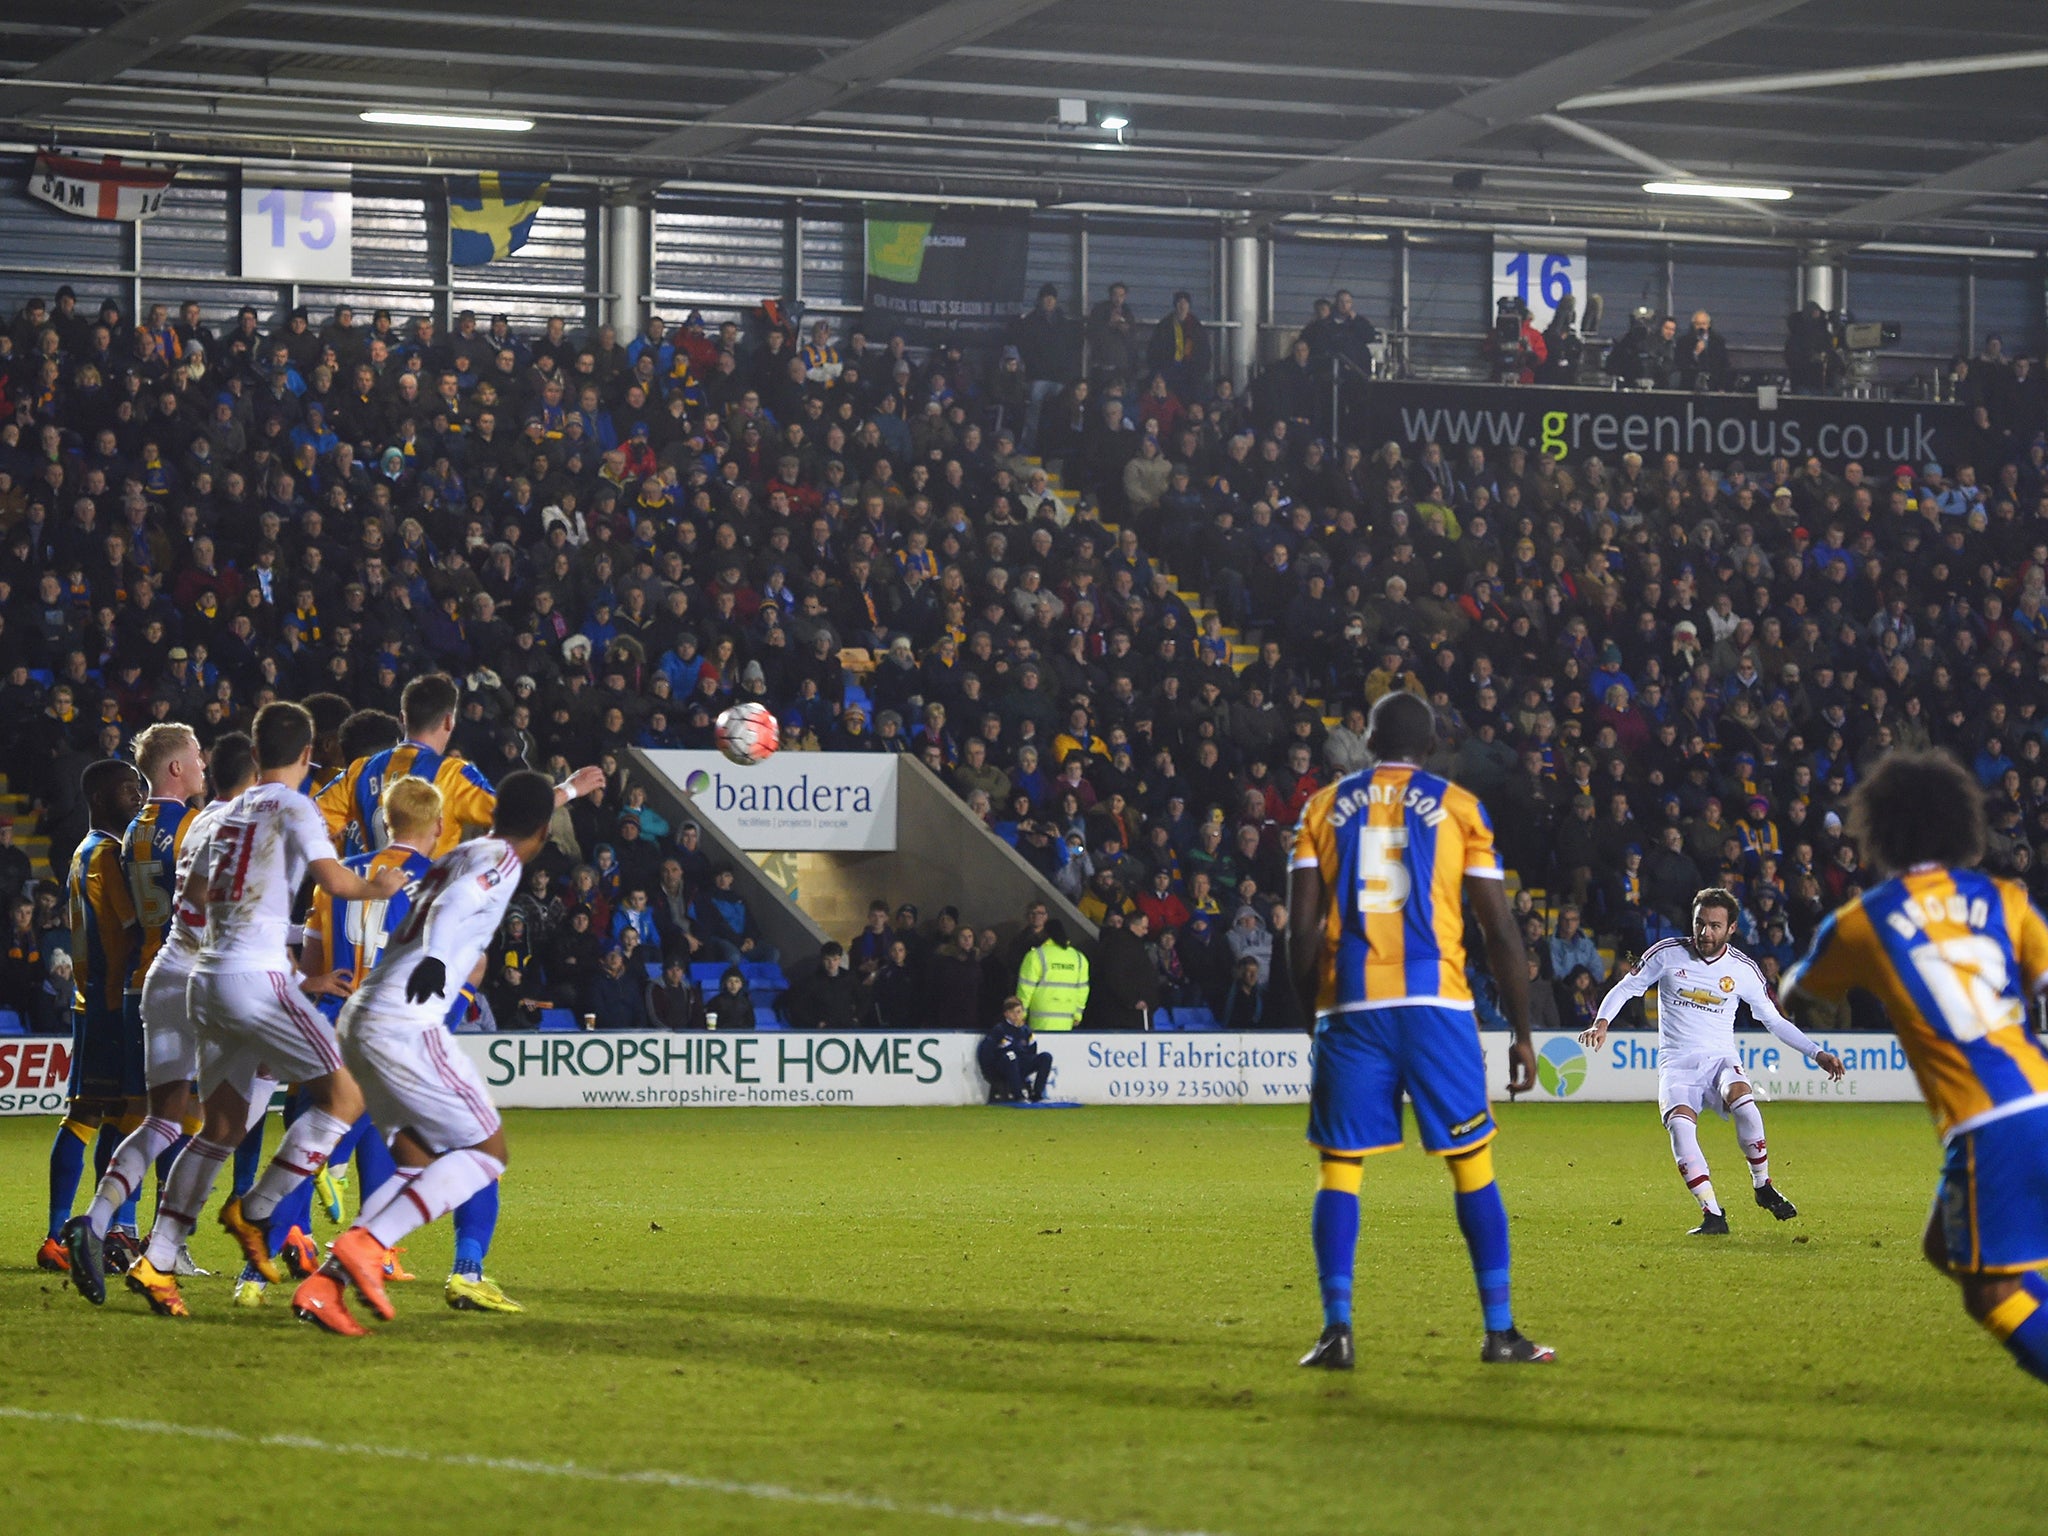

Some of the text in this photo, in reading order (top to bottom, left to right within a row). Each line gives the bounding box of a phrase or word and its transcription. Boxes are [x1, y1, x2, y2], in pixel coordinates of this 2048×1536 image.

[42, 173, 84, 208] SAM
[258, 186, 336, 251] 15
[1506, 250, 1572, 312] 16
[1401, 402, 1937, 462] www.greenhous.co.uk
[714, 773, 872, 812] bandera
[1357, 826, 1411, 914] 5
[0, 1043, 73, 1088] SEM
[487, 1038, 942, 1086] SHROPSHIRE HOMES
[1088, 1041, 1147, 1068] Steel
[1158, 1041, 1297, 1068] Fabricators
[1803, 1040, 1907, 1070] Chamb
[582, 1086, 854, 1107] www.shropshire-homes.com
[1109, 1080, 1169, 1097] 01939
[1178, 1080, 1249, 1097] 235000
[1752, 1081, 1857, 1096] OMMERCE
